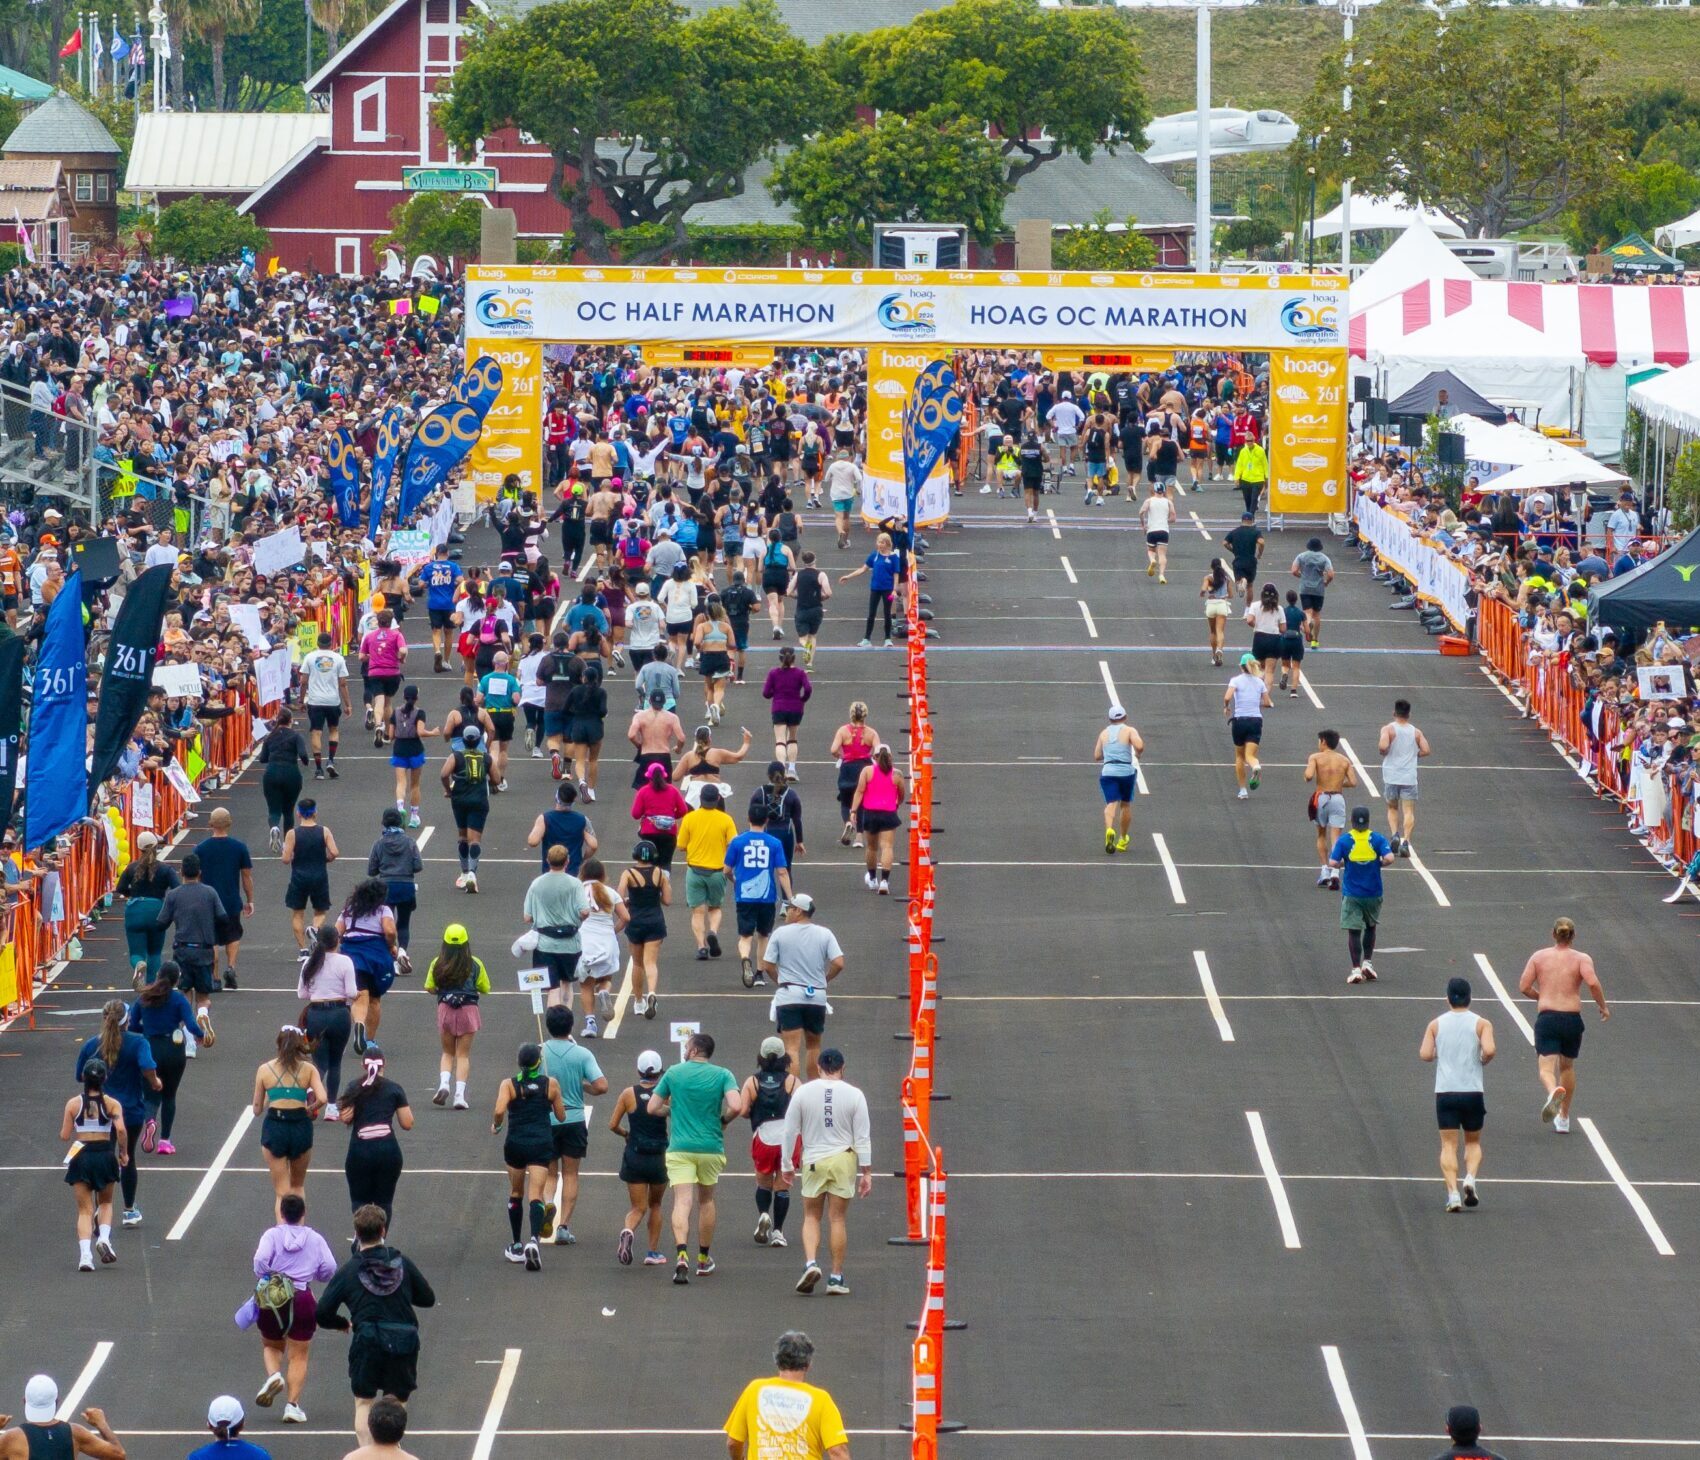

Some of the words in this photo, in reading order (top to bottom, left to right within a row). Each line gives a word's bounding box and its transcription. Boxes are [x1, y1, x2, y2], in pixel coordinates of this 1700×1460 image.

[464, 173, 487, 189] BARN
[577, 301, 616, 321] OC
[626, 302, 684, 322] HALF
[692, 303, 834, 323] MARATHON
[970, 305, 1048, 325] HOAG
[1057, 306, 1096, 326] OC
[1105, 307, 1247, 328] MARATHON
[919, 389, 963, 431] OC
[418, 407, 481, 447] OC
[113, 643, 157, 674] 361°
[41, 661, 83, 695] 361°
[743, 845, 770, 868] 29
[824, 1088, 833, 1104] RUN
[824, 1105, 833, 1116] OC
[824, 1117, 834, 1128] 26
